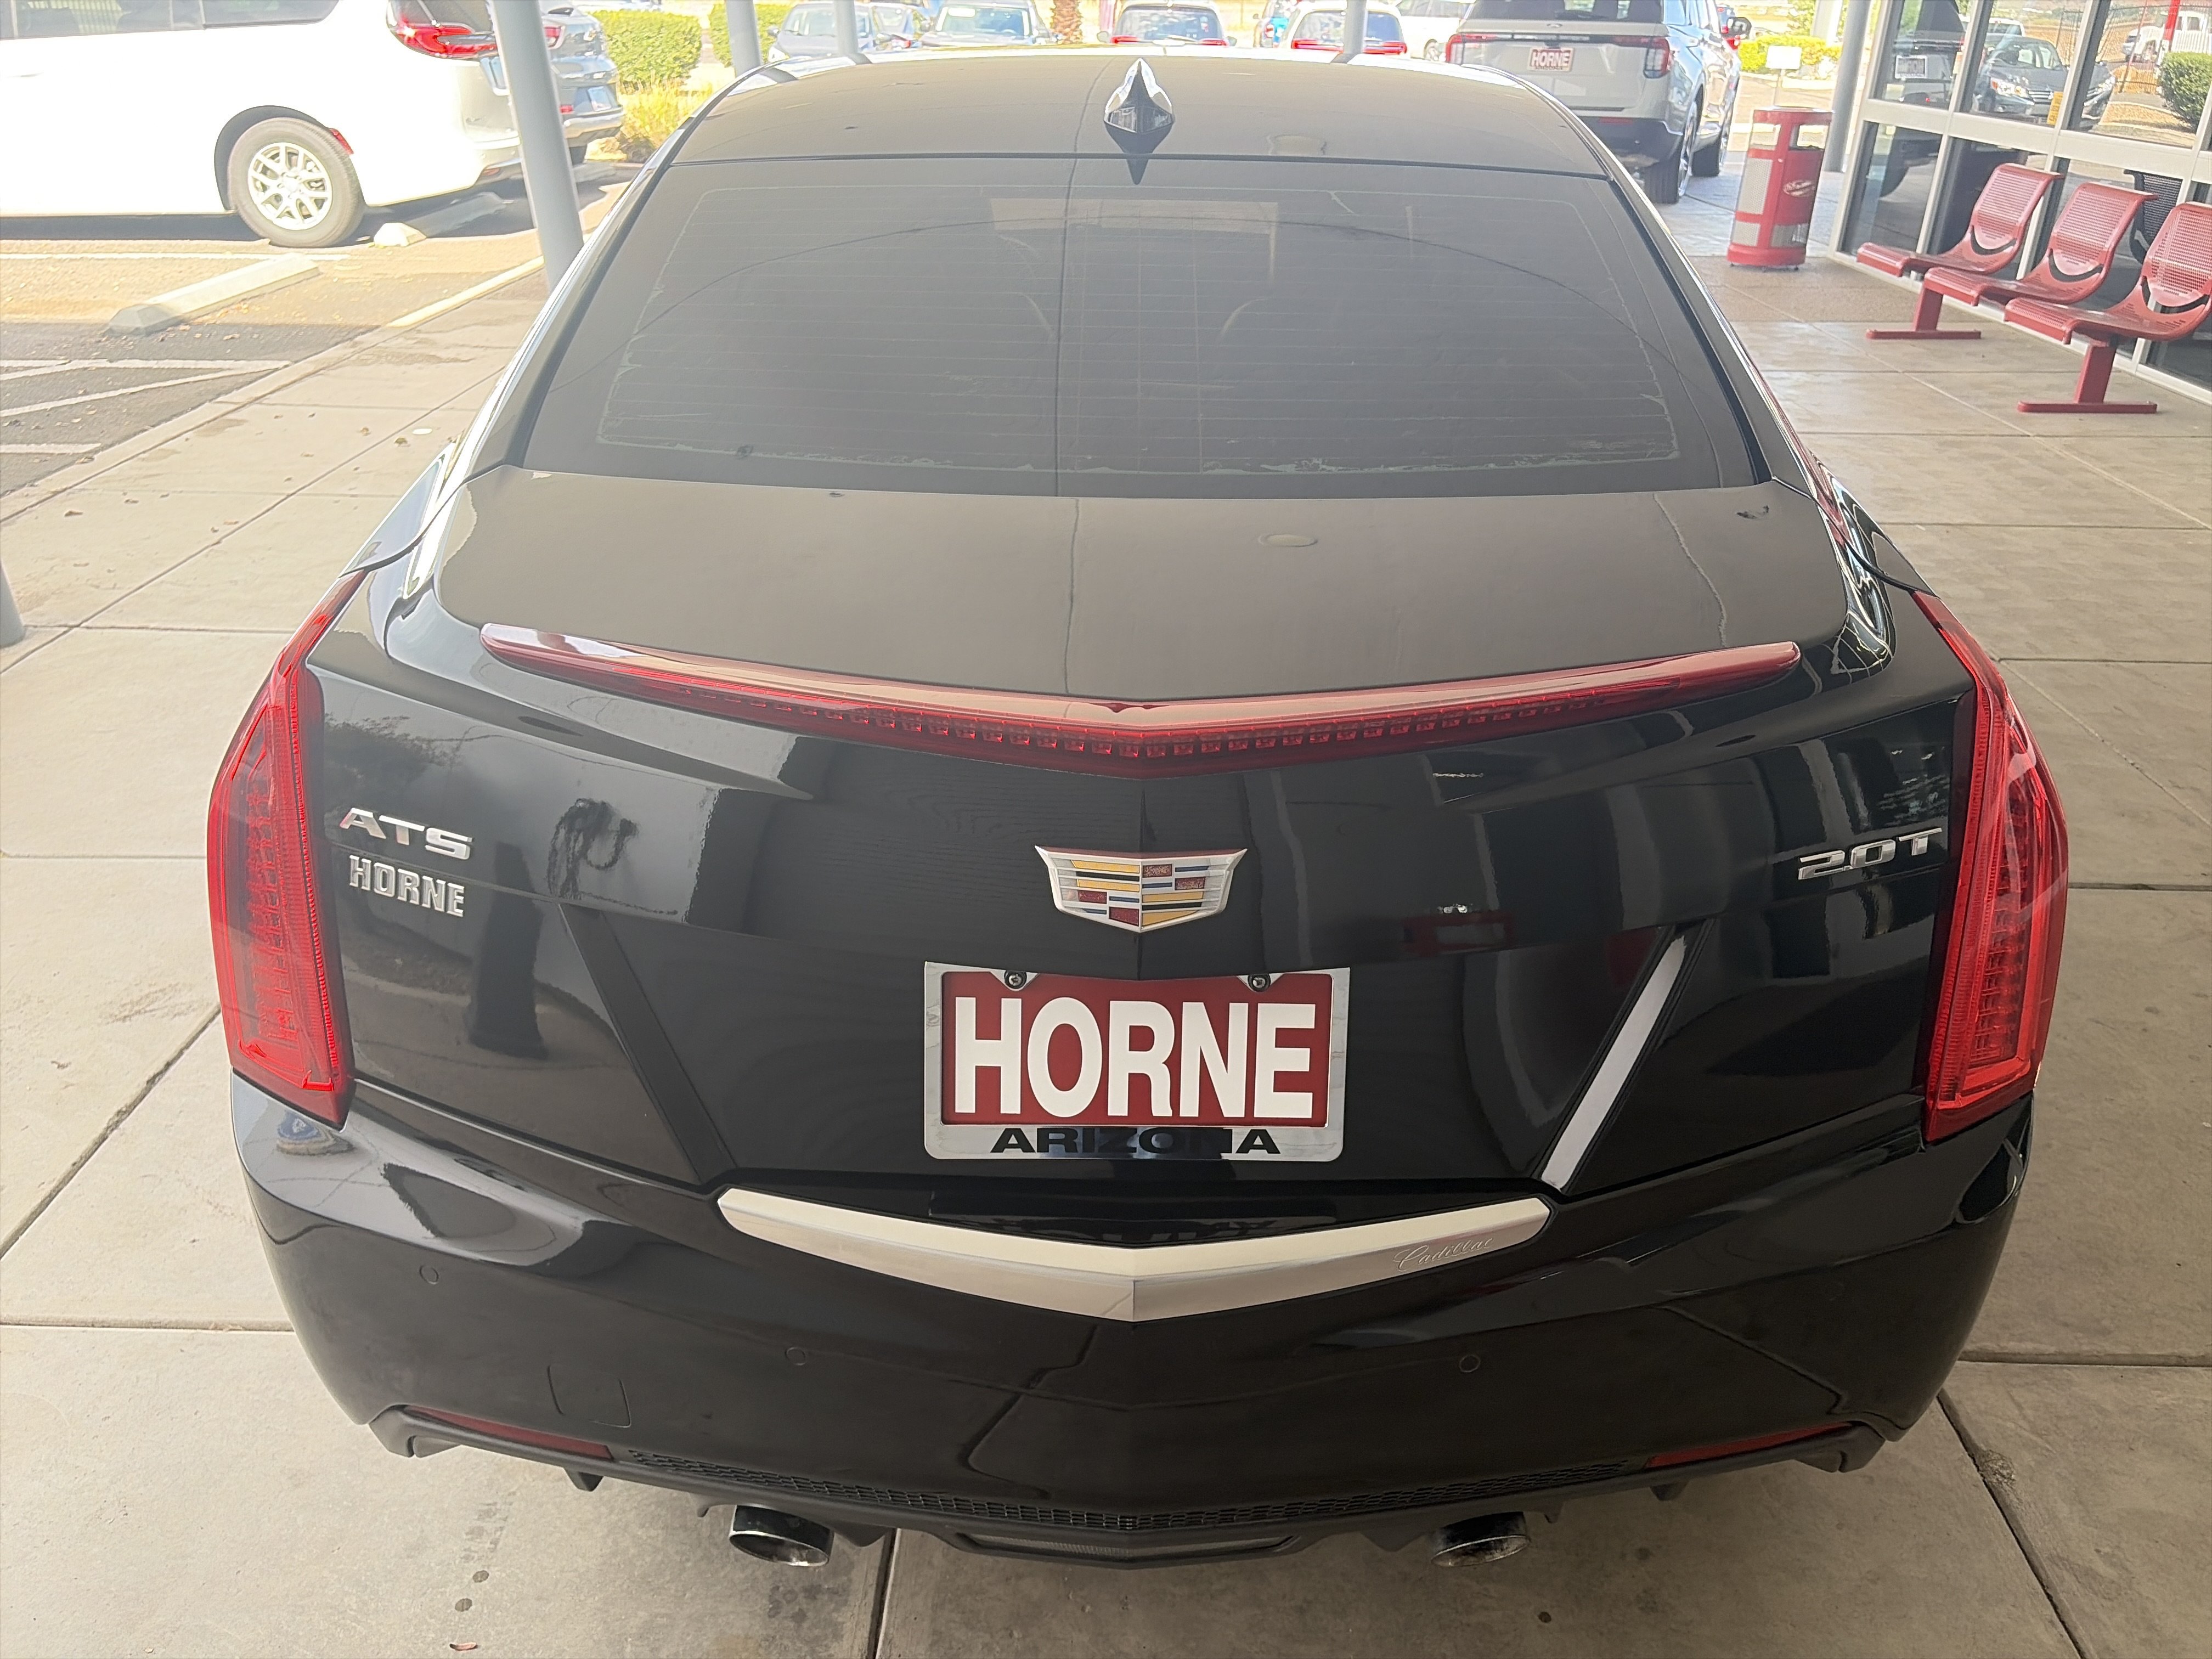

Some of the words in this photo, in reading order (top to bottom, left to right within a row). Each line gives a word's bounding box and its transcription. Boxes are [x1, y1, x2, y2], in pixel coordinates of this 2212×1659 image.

[1531, 52, 1570, 66] HORNE
[339, 808, 473, 860] ATS
[1798, 827, 1943, 880] 2.0T
[349, 855, 465, 917] HORNE
[955, 996, 1316, 1118] HORNE
[1393, 1238, 1493, 1272] Cadillac
